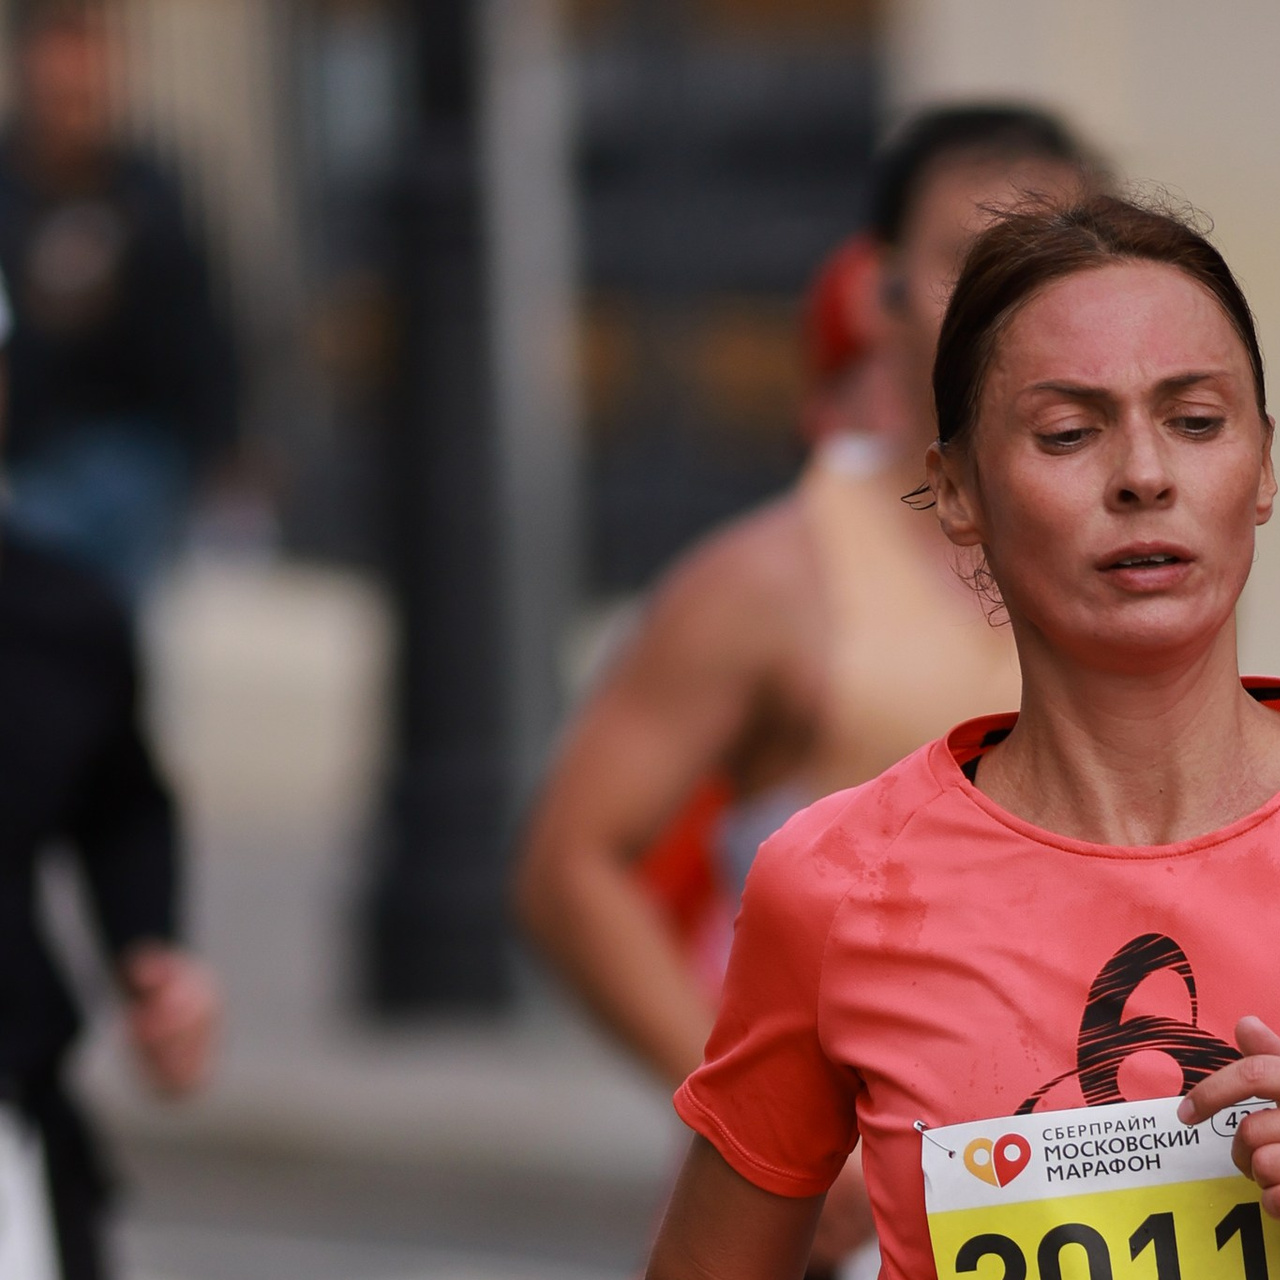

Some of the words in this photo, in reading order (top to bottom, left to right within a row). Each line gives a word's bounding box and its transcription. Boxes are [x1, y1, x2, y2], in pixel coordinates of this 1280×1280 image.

[1042, 1116, 1157, 1141] СБЕРПРАЙМ
[1044, 1124, 1200, 1162] МОСКОВСКИЙ
[1046, 1153, 1161, 1182] МАРАФОН
